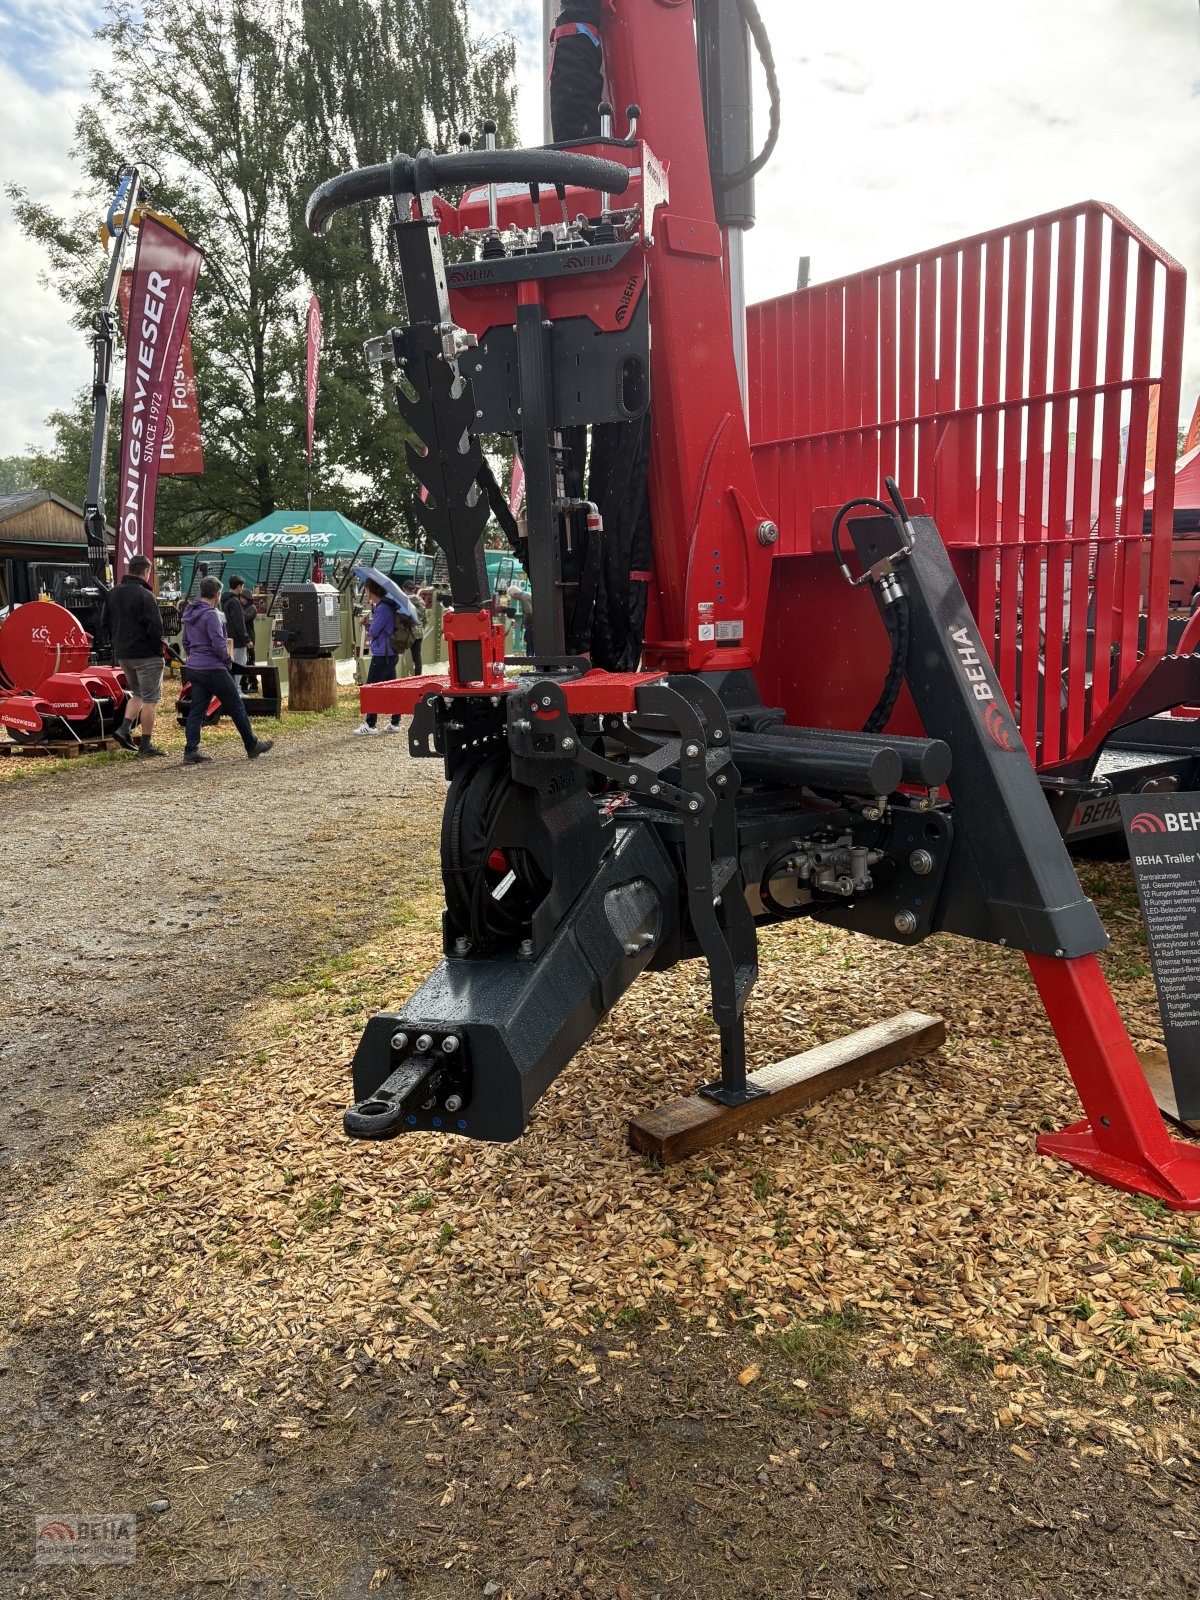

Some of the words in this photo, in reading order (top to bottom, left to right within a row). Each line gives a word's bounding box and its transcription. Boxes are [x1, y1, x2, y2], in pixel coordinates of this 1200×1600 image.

[582, 253, 613, 267] BEHA
[466, 268, 494, 282] BEHA
[621, 275, 639, 309] BEHA
[150, 392, 162, 422] 1972
[144, 423, 157, 463] SINCE
[242, 532, 333, 544] MOTOREX
[240, 543, 254, 551] Oil
[951, 626, 994, 701] BEHA
[1, 714, 37, 728] KÖNIGSWIESER
[1135, 854, 1163, 866] BEHA
[1164, 853, 1195, 864] Trailer
[1140, 872, 1181, 881] Zentralrahmen
[1152, 880, 1197, 889] Gesamtgewicht
[1151, 889, 1190, 898] Rungenhalter
[1149, 898, 1173, 907] Rungen
[1146, 906, 1197, 915] LED-Beleuchtung
[1147, 915, 1188, 923] Seitenstrahler
[1149, 923, 1184, 932] Unterlegkeil
[1150, 931, 1189, 941] Lenkdeichsel
[1152, 940, 1189, 949] Lenkzylinder
[1155, 958, 1181, 967] (Bremse
[1167, 1002, 1191, 1010] Rungen
